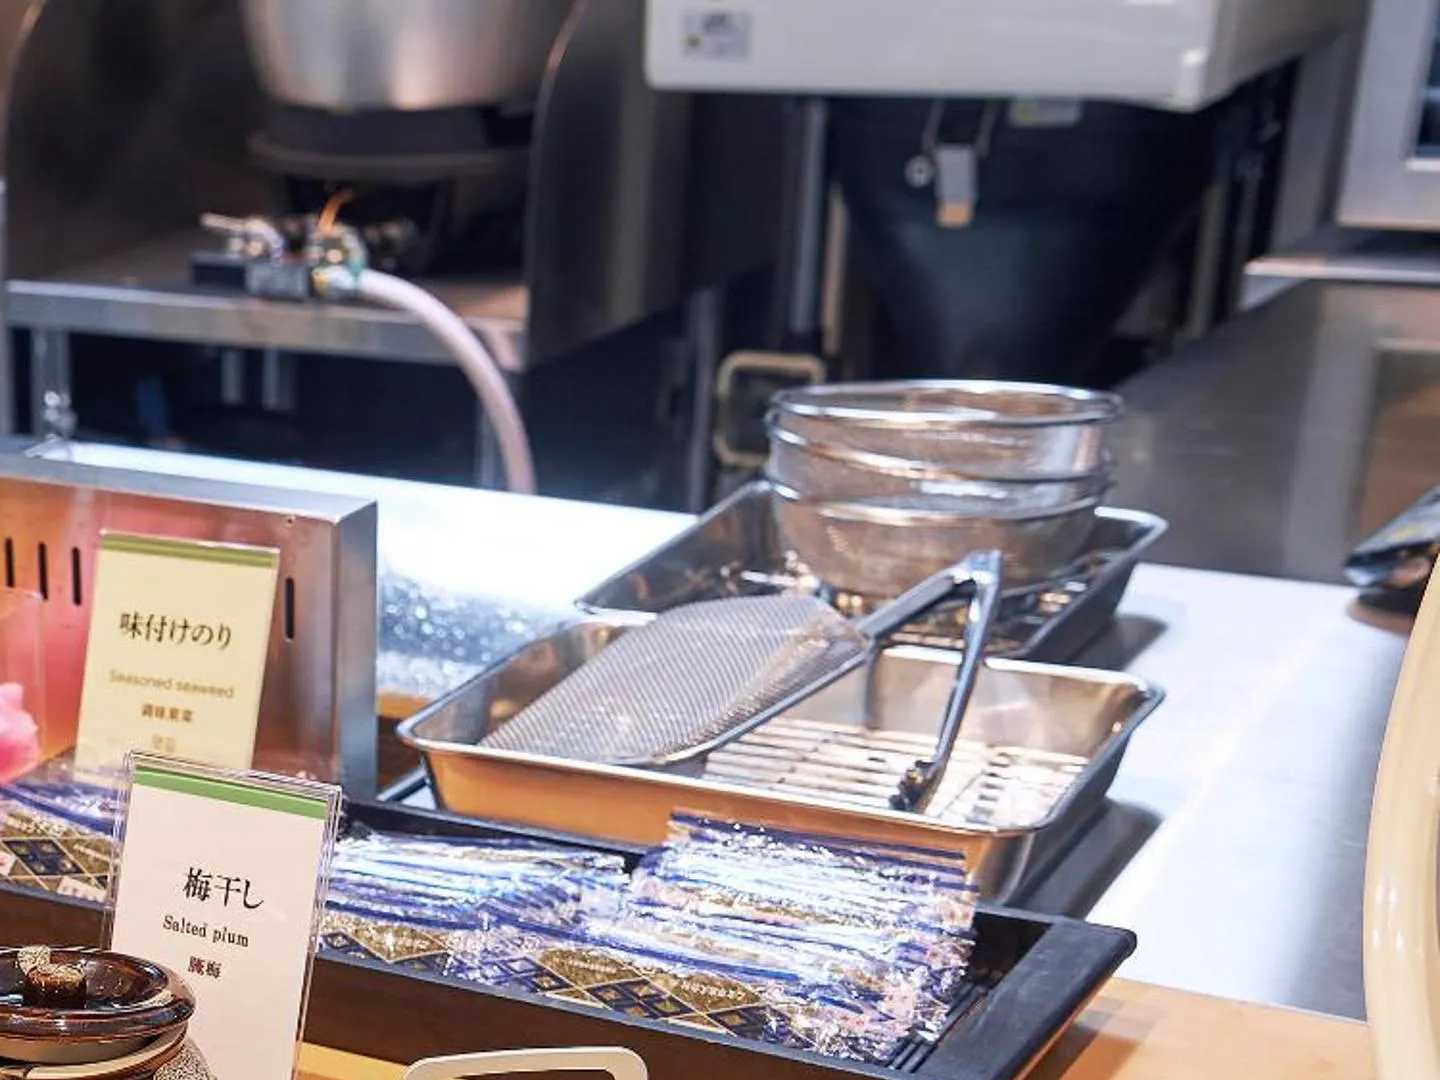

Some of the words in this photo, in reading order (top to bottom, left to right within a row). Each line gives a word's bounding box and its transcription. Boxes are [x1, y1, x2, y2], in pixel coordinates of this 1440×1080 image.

[119, 611, 232, 650] 味付けのり
[109, 668, 173, 690] Seasoned
[176, 681, 235, 699] seaweed
[183, 867, 264, 909] 梅干し
[163, 915, 208, 938] Salted
[212, 926, 249, 948] plum
